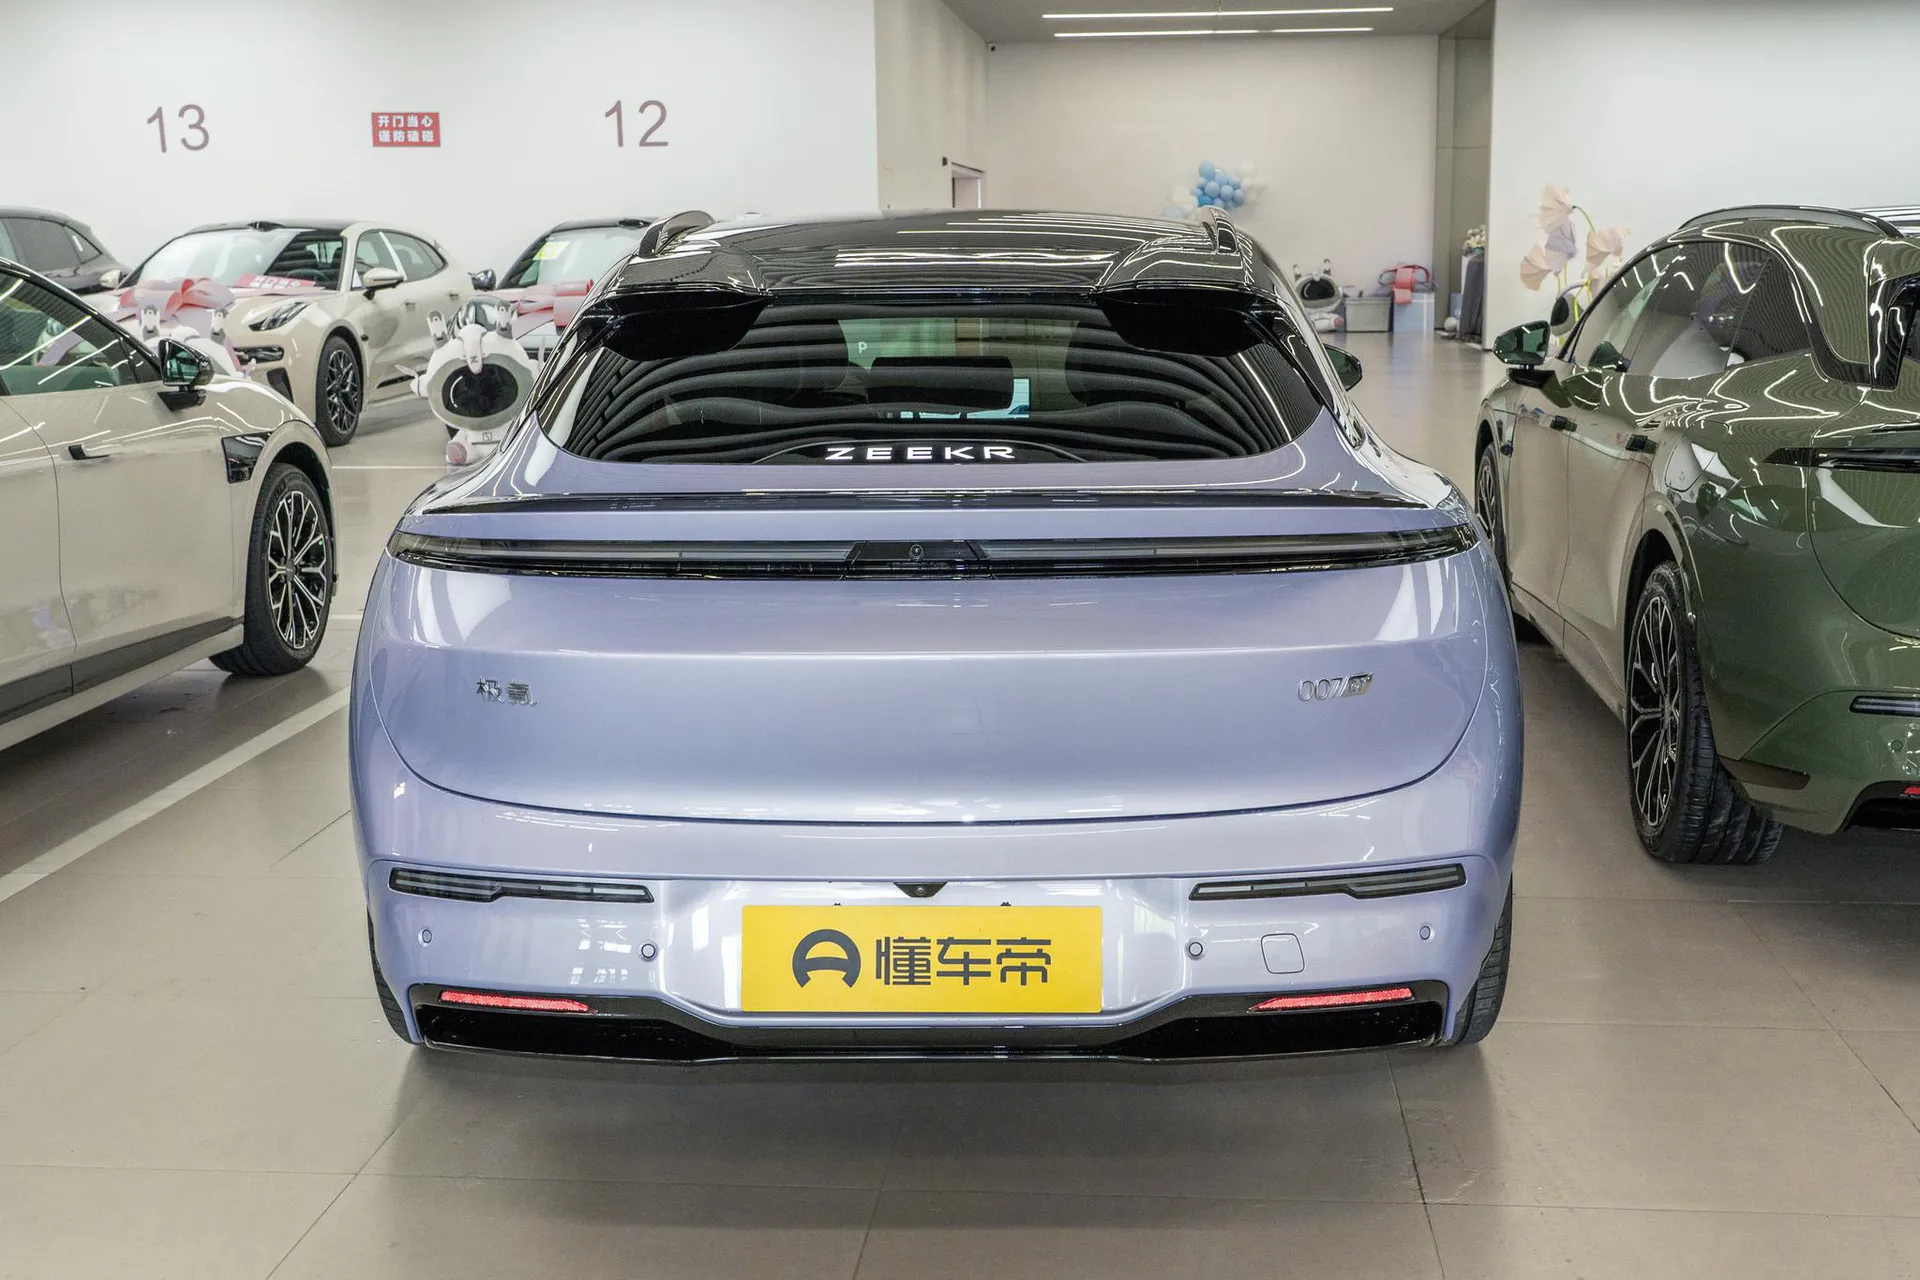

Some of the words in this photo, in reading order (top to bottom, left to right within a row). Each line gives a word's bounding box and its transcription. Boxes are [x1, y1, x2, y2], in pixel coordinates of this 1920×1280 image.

[146, 104, 209, 153] 13
[377, 114, 433, 128] 开门当心
[605, 99, 668, 147] 12
[858, 341, 868, 354] P
[825, 446, 1015, 460] ZEEKR
[476, 677, 538, 706] 极氪
[875, 936, 1052, 986] 懂车帝
